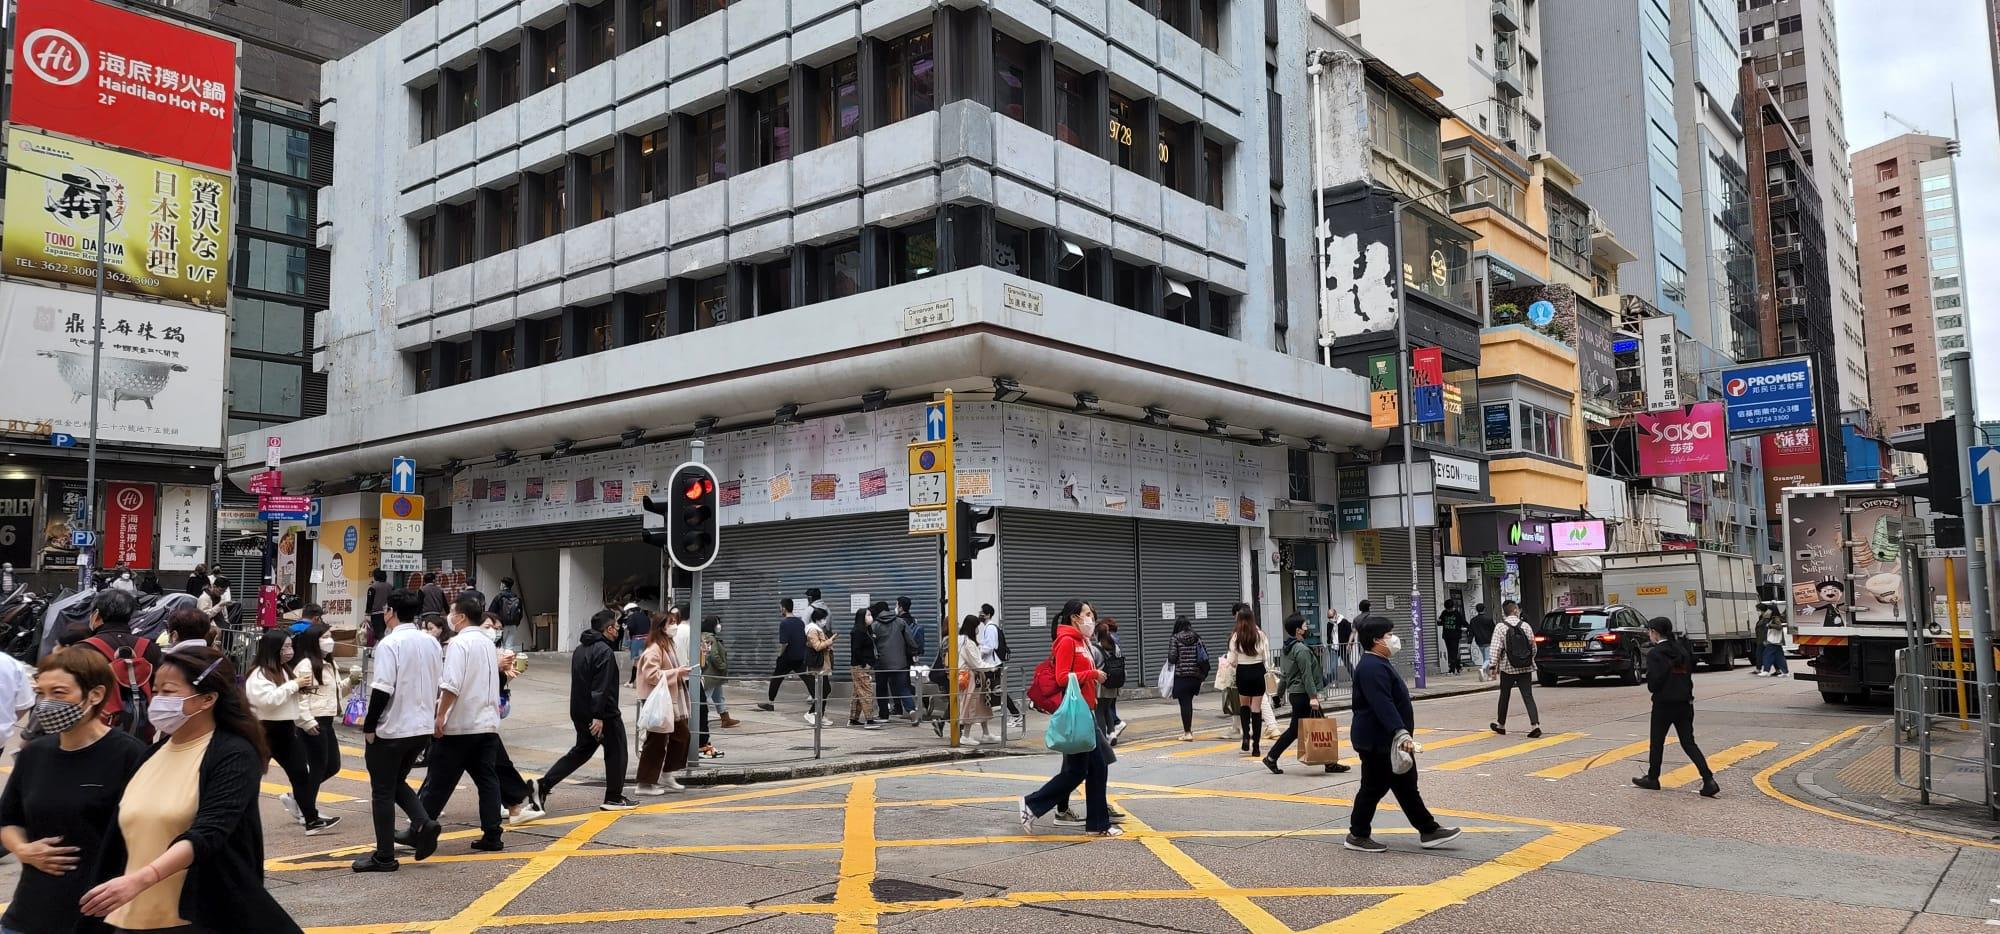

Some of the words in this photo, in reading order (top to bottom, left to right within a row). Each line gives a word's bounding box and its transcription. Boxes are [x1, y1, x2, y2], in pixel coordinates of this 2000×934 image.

[37, 40, 74, 72] Hi
[99, 51, 226, 104] 海底撈火鍋
[98, 75, 167, 104] Haidilao
[169, 93, 197, 113] Hot
[199, 101, 225, 120] Pot
[98, 93, 117, 106] 2F
[147, 170, 179, 277] 日本料理
[191, 177, 223, 260] 贅沢な
[45, 232, 75, 248] TONO
[82, 238, 124, 257] DAKIYA
[45, 246, 82, 259] Japanese
[82, 252, 123, 265] Resturant
[41, 260, 68, 273] 3622
[72, 266, 98, 278] 3000
[106, 271, 132, 283] 3622
[134, 276, 160, 287] 3009
[187, 265, 217, 283] 1/F
[1028, 292, 1040, 301] Road
[935, 302, 949, 311] Road
[1660, 333, 1675, 400] 豪華體育用品
[1748, 371, 1805, 387] PROMISE
[56, 436, 68, 447] P
[1670, 443, 1694, 454] 莎莎
[933, 475, 939, 486] 7
[933, 491, 940, 502] 7
[1862, 498, 1899, 509] Dreyer's
[309, 501, 319, 525] P
[0, 525, 16, 546] 6
[75, 533, 86, 544] P
[125, 514, 139, 562] 海底撈火鍋
[1311, 731, 1333, 742] MUJI
